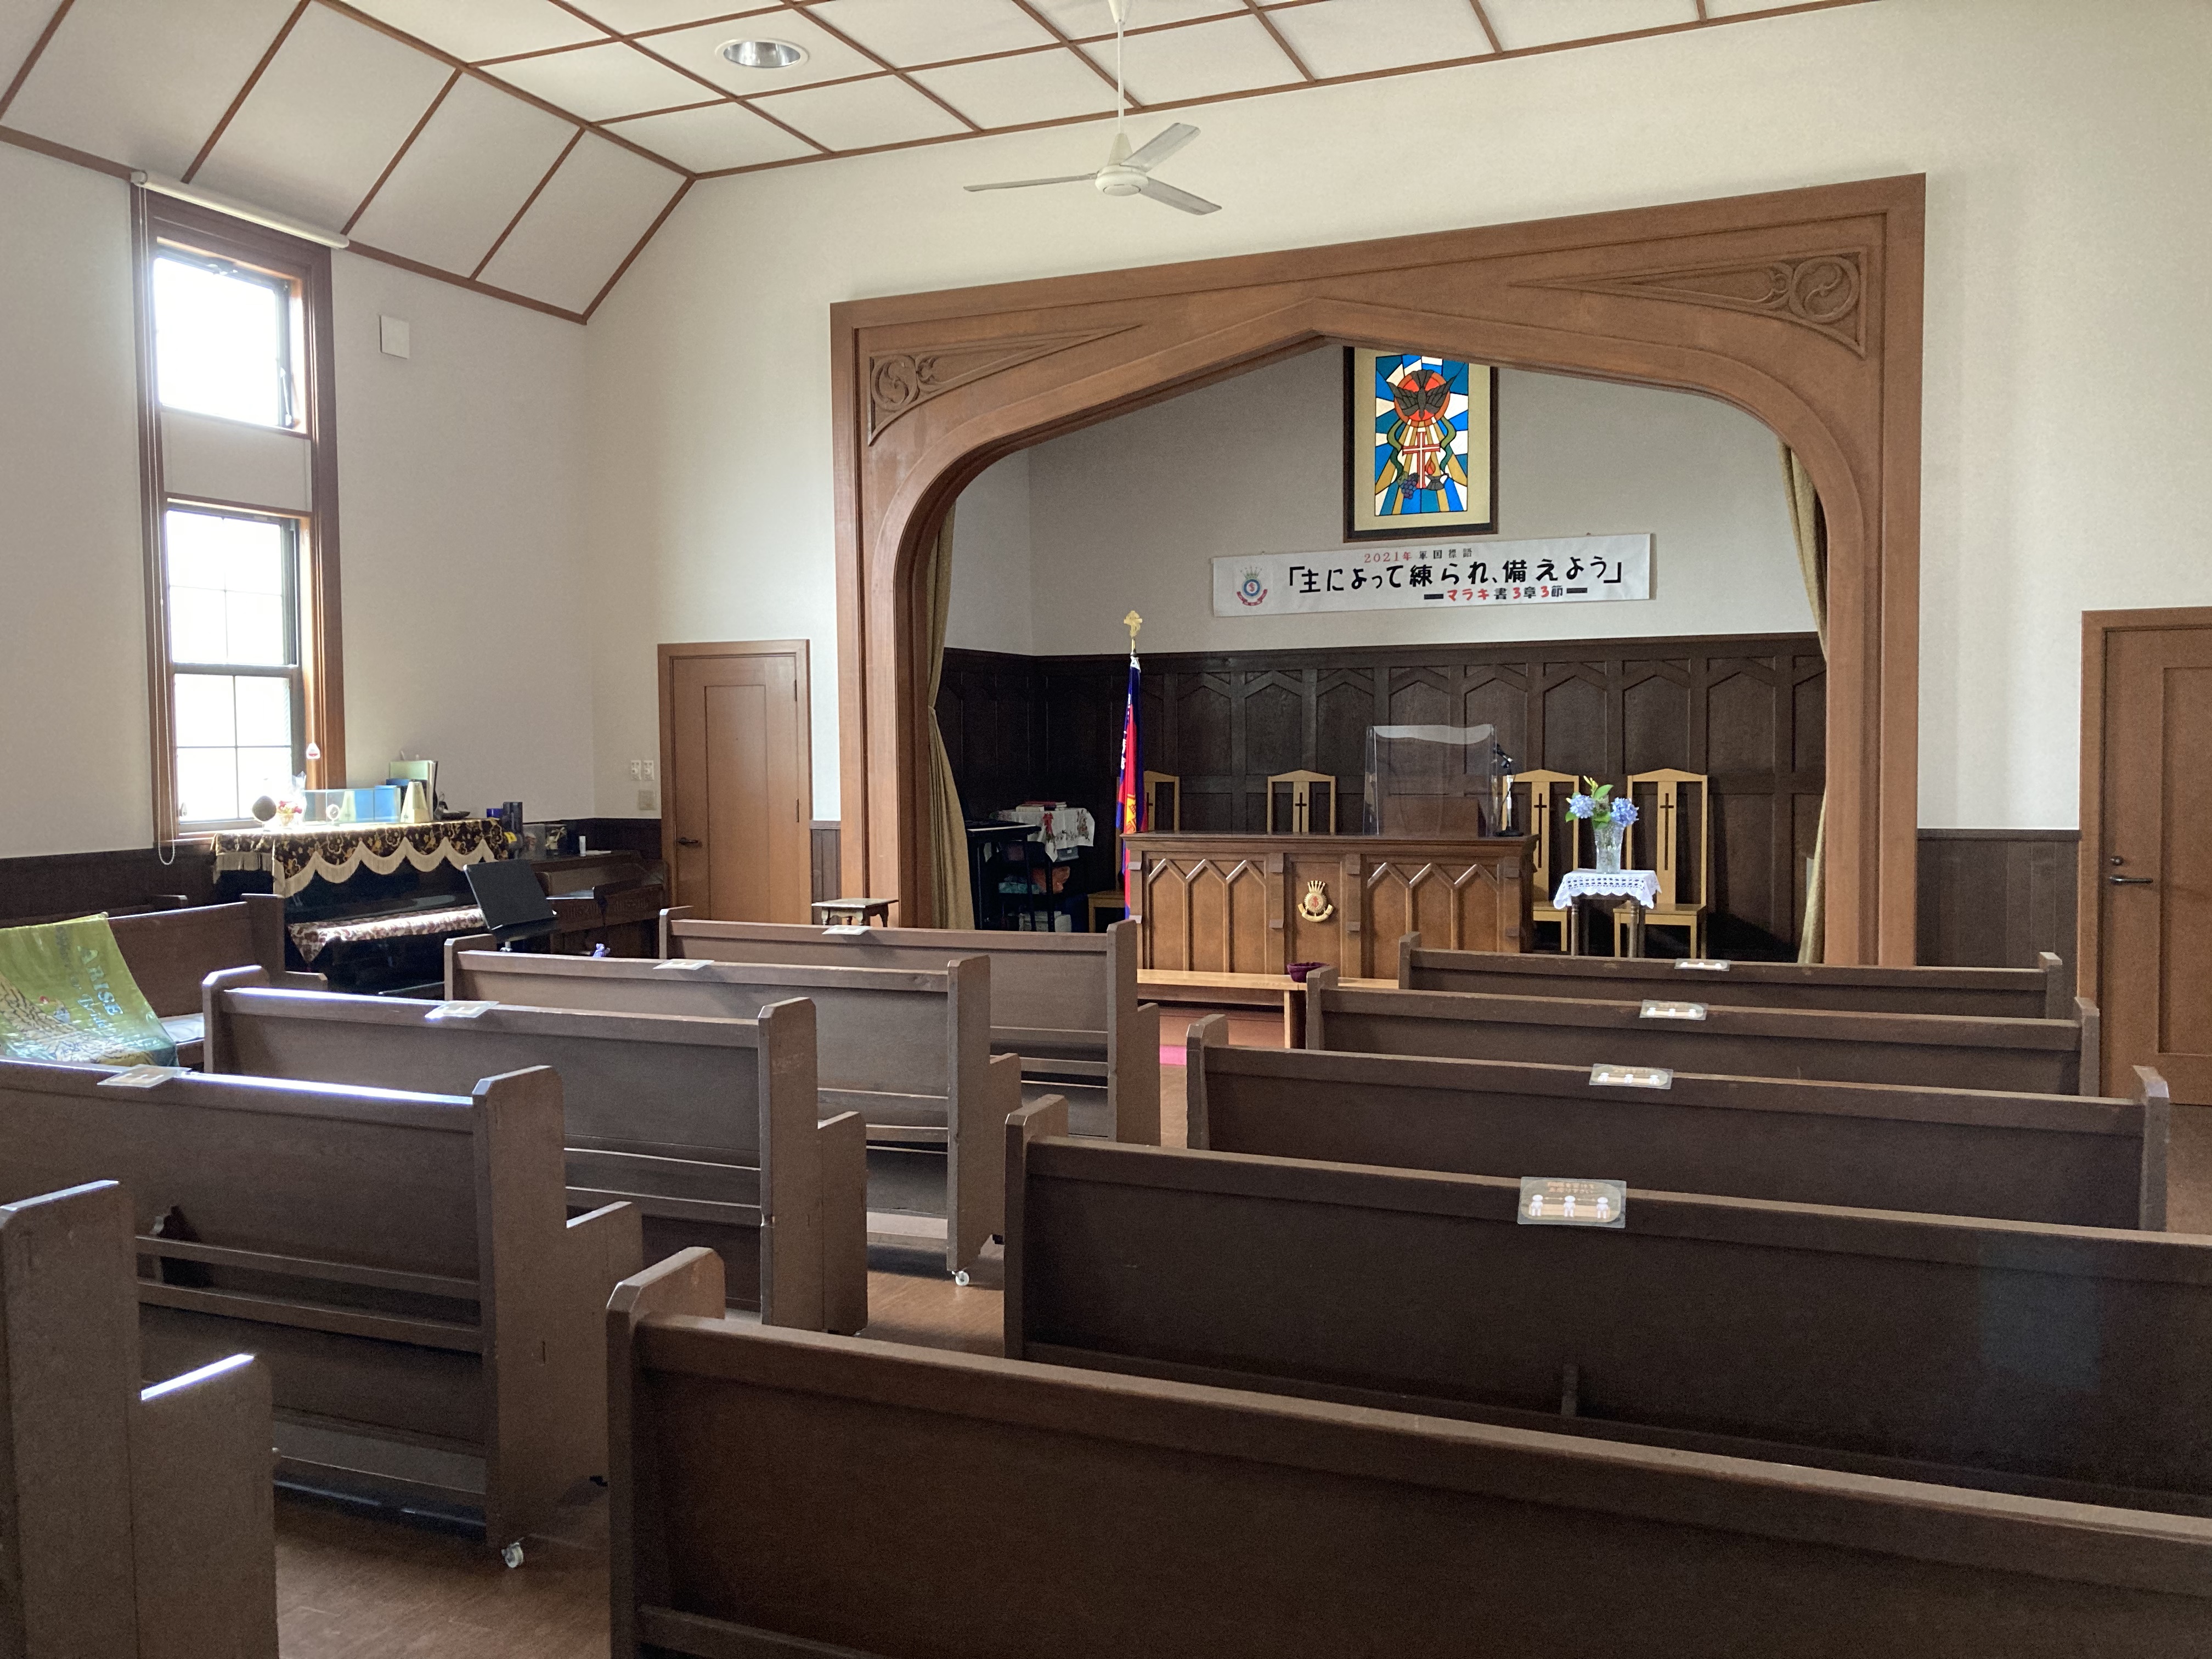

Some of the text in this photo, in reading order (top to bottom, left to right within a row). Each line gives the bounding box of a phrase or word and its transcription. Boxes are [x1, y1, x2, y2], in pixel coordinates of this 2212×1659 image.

[1289, 556, 1621, 593] 「主によって練られ、備えよう」
